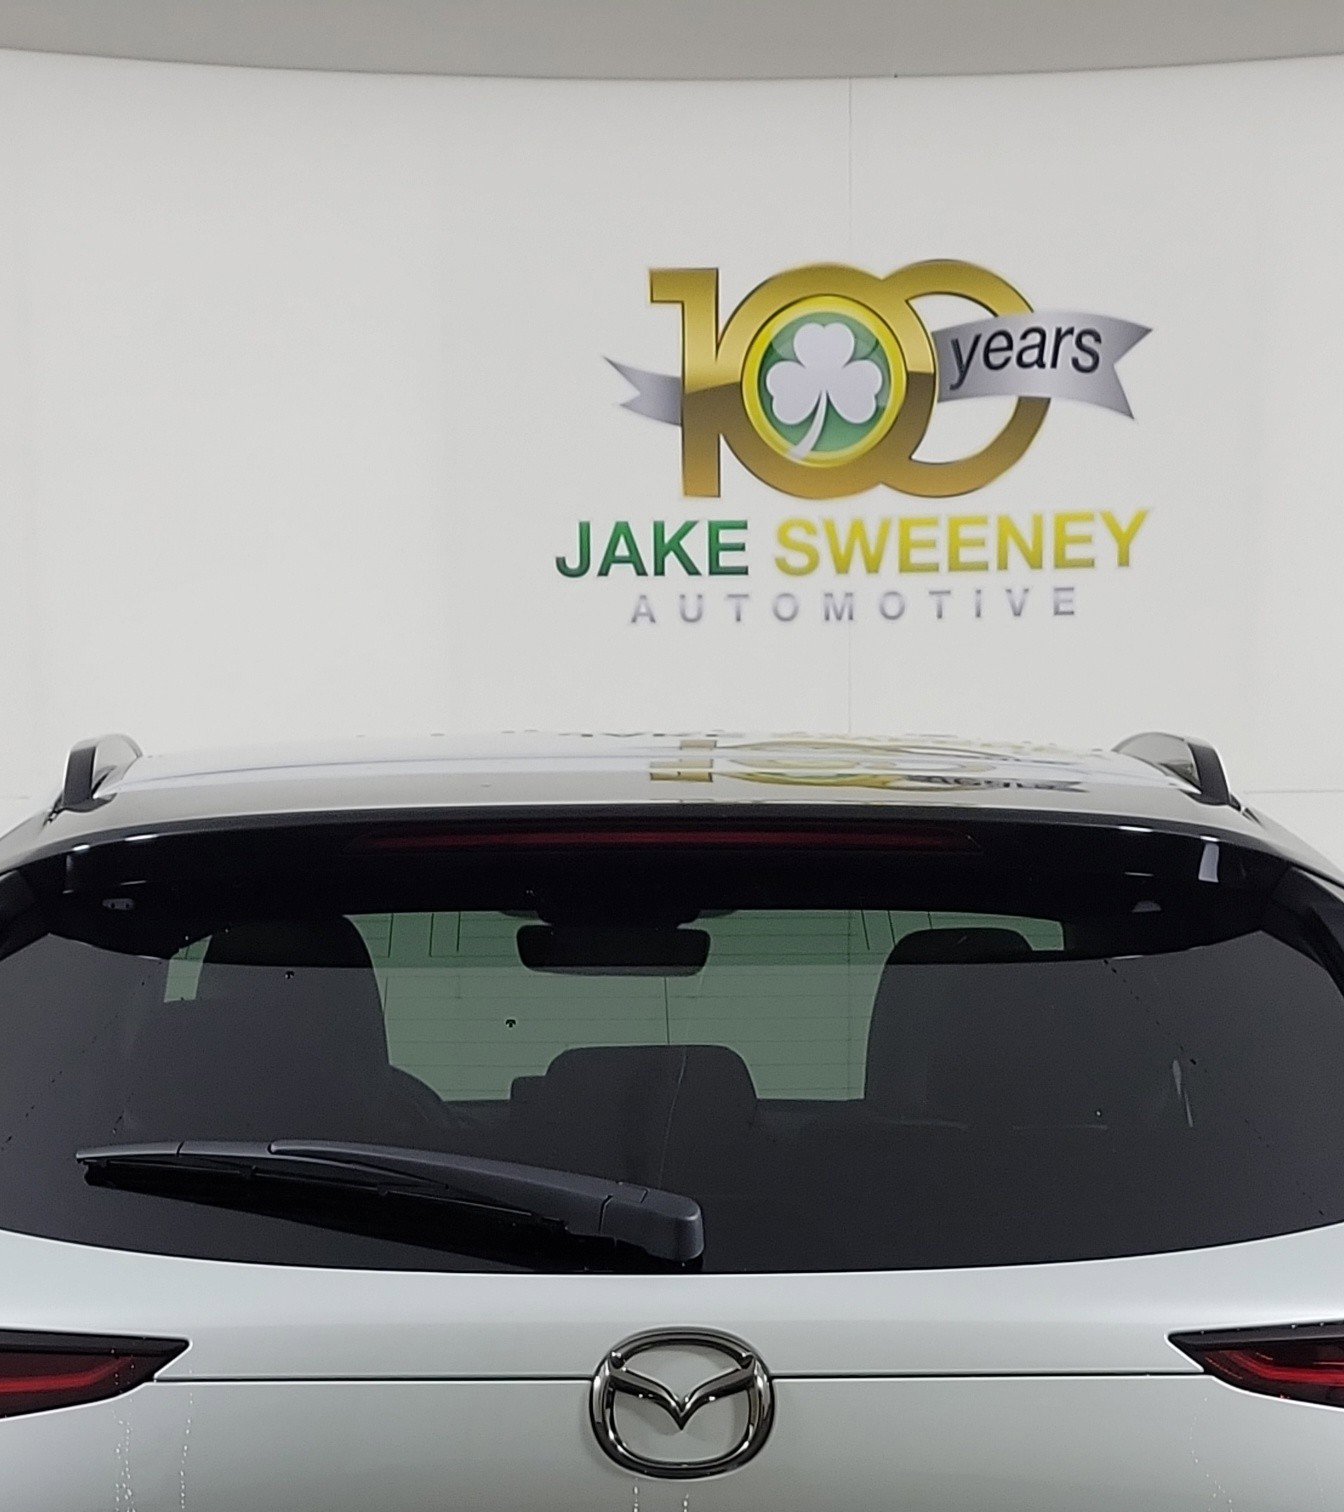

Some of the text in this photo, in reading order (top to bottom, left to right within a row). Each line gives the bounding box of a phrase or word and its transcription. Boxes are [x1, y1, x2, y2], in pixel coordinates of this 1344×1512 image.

[948, 324, 1102, 391] years
[555, 510, 1150, 579] JAKE SWEENEY
[629, 586, 1077, 626] AUTOMOTIVE
